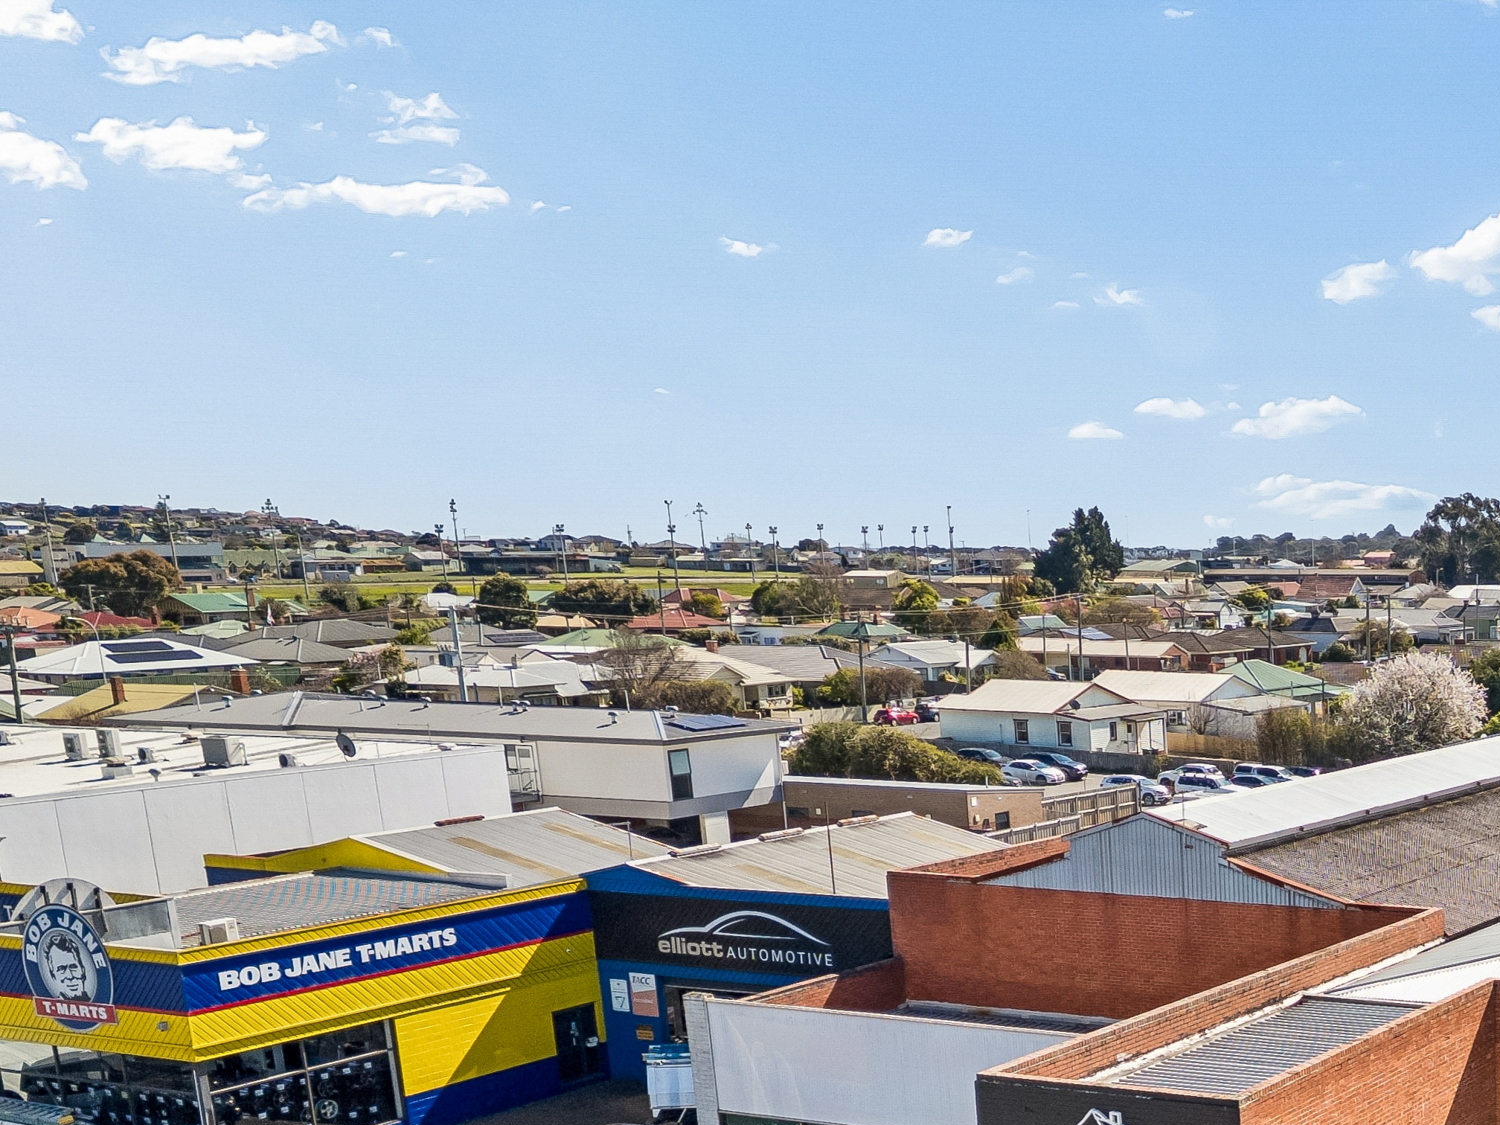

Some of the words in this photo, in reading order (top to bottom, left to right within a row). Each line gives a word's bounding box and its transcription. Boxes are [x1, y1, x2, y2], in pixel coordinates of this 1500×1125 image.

[26, 912, 52, 963] BOB
[57, 912, 107, 969] JANE
[217, 961, 282, 991] BOB
[284, 948, 352, 978] JANE
[355, 928, 457, 963] T-MARTS
[657, 937, 724, 958] elliott
[726, 946, 833, 967] AUTOMOTIVE
[42, 1001, 108, 1020] T-MARTS
